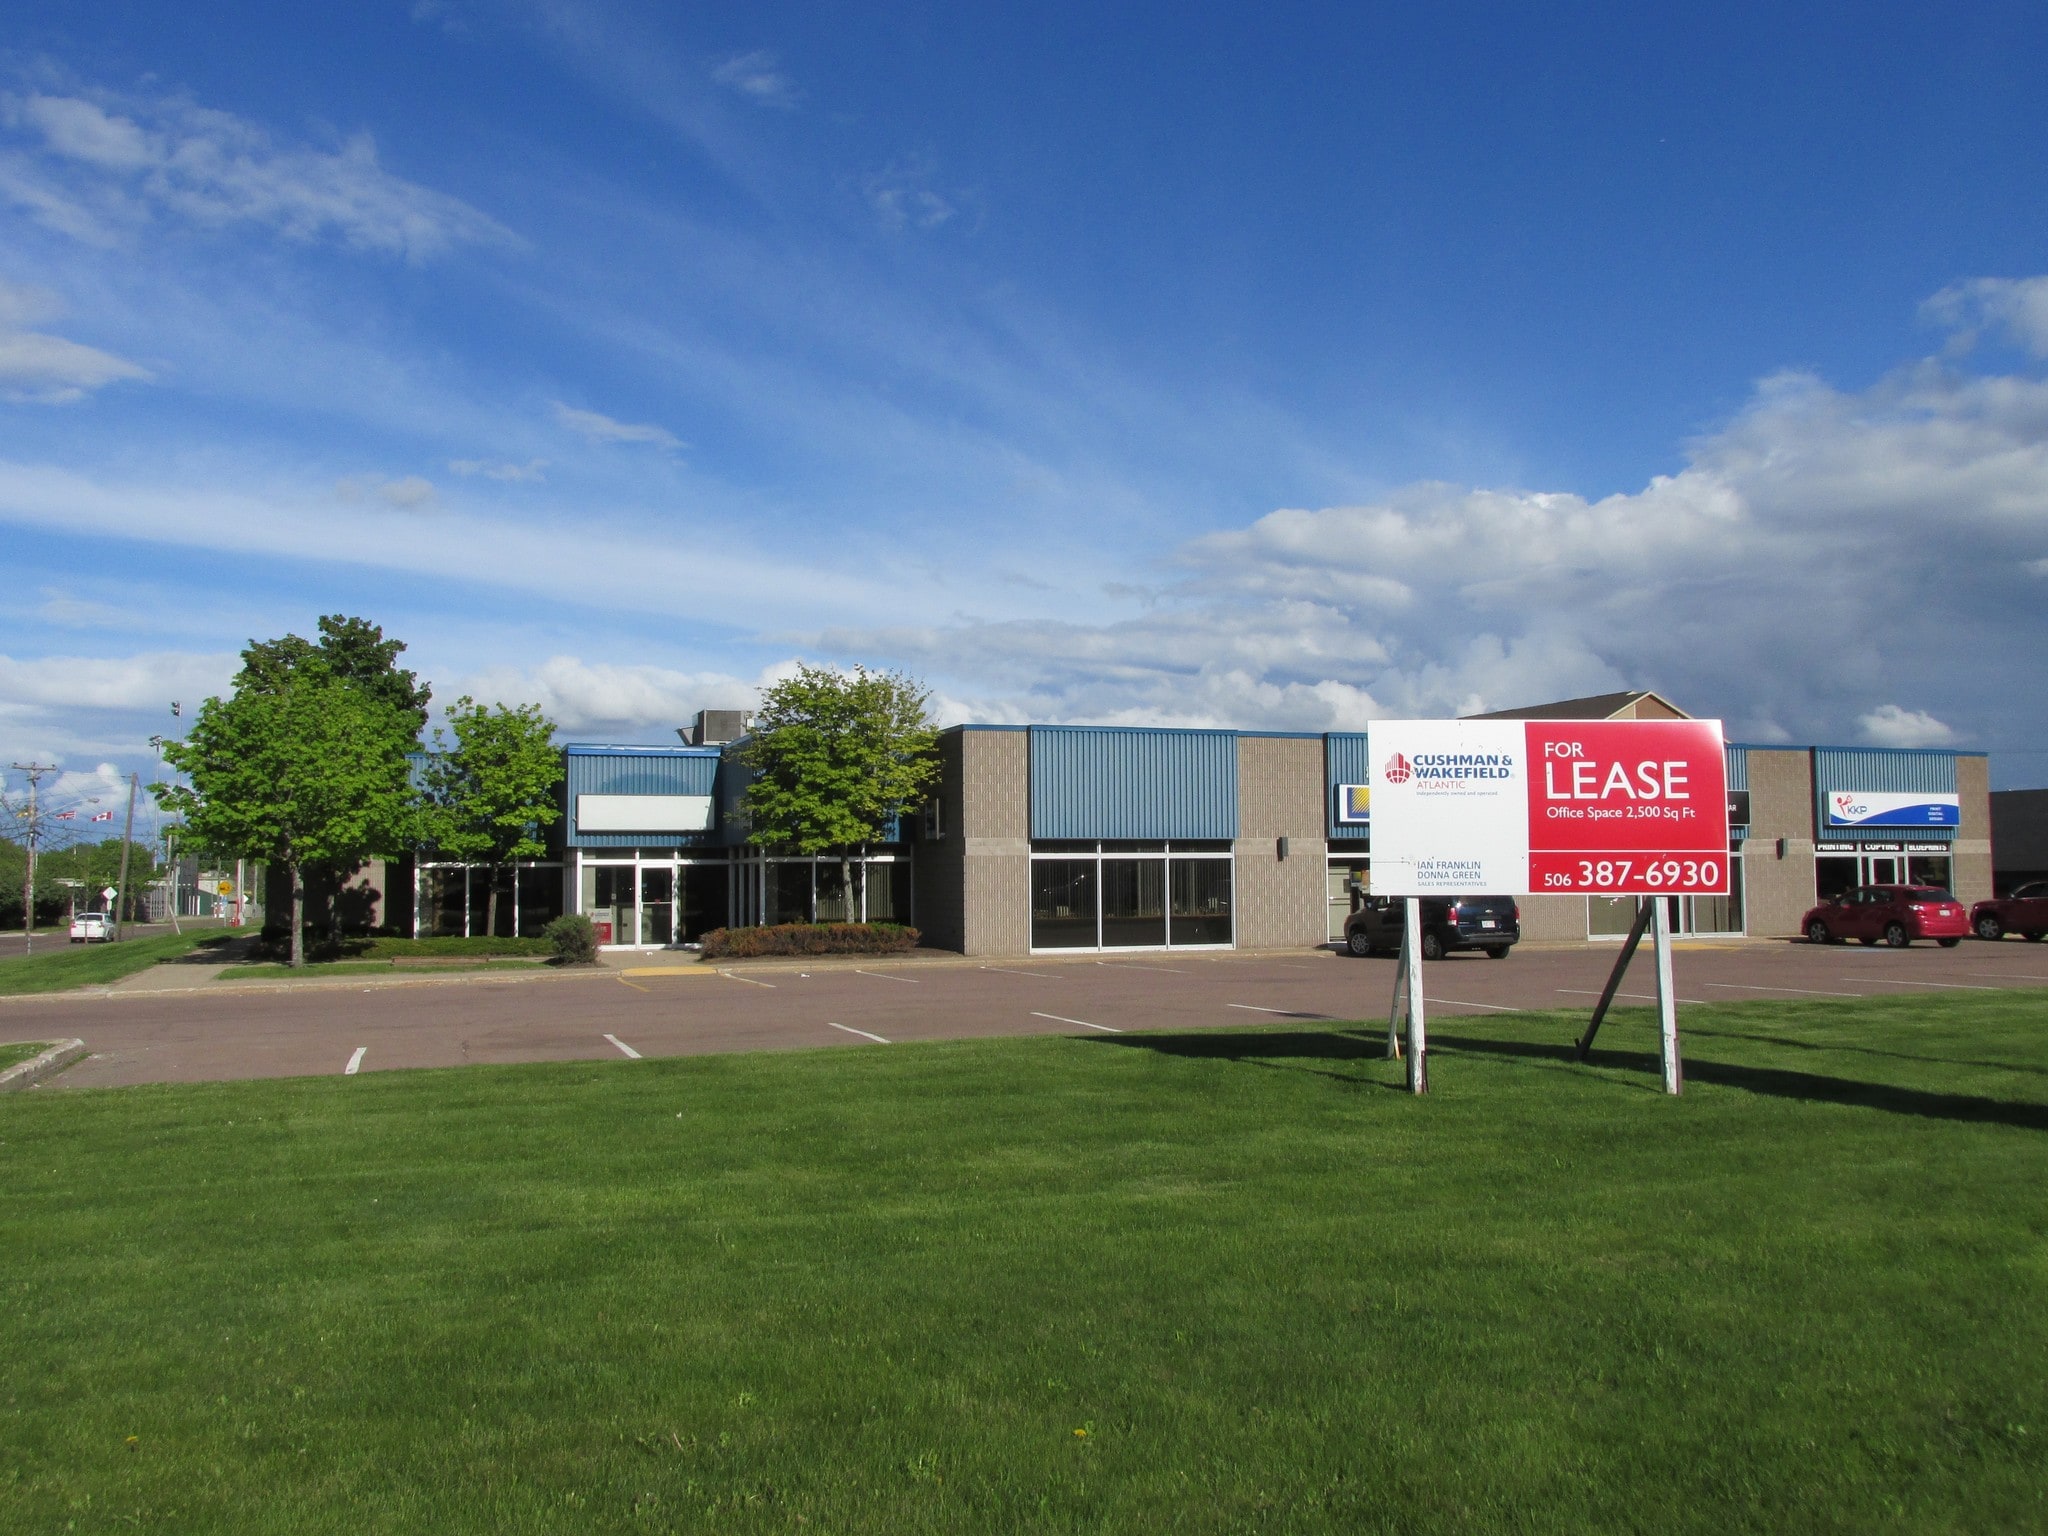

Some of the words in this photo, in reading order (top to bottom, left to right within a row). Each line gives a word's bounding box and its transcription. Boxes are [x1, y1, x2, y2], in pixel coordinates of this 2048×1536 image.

[1544, 742, 1585, 758] FOR
[1413, 754, 1499, 766] CUSHMAN
[1501, 754, 1513, 766] &
[1414, 767, 1510, 779] WAKEFIELD
[1416, 780, 1466, 790] ATLANTIC
[1545, 760, 1690, 800] LEASE
[1546, 806, 1584, 819] Office
[1587, 806, 1623, 821] Space
[1626, 806, 1660, 819] 2,500
[1663, 807, 1679, 821] Sq
[1682, 807, 1696, 818] Ft
[1847, 805, 1867, 815] KKP
[1417, 861, 1434, 870] IAN
[1436, 861, 1481, 870] FRANKLIN
[1417, 870, 1450, 879] DONNA
[1452, 870, 1481, 879] GREEN
[1543, 873, 1572, 887] 506
[1578, 860, 1719, 887] 387-6930
